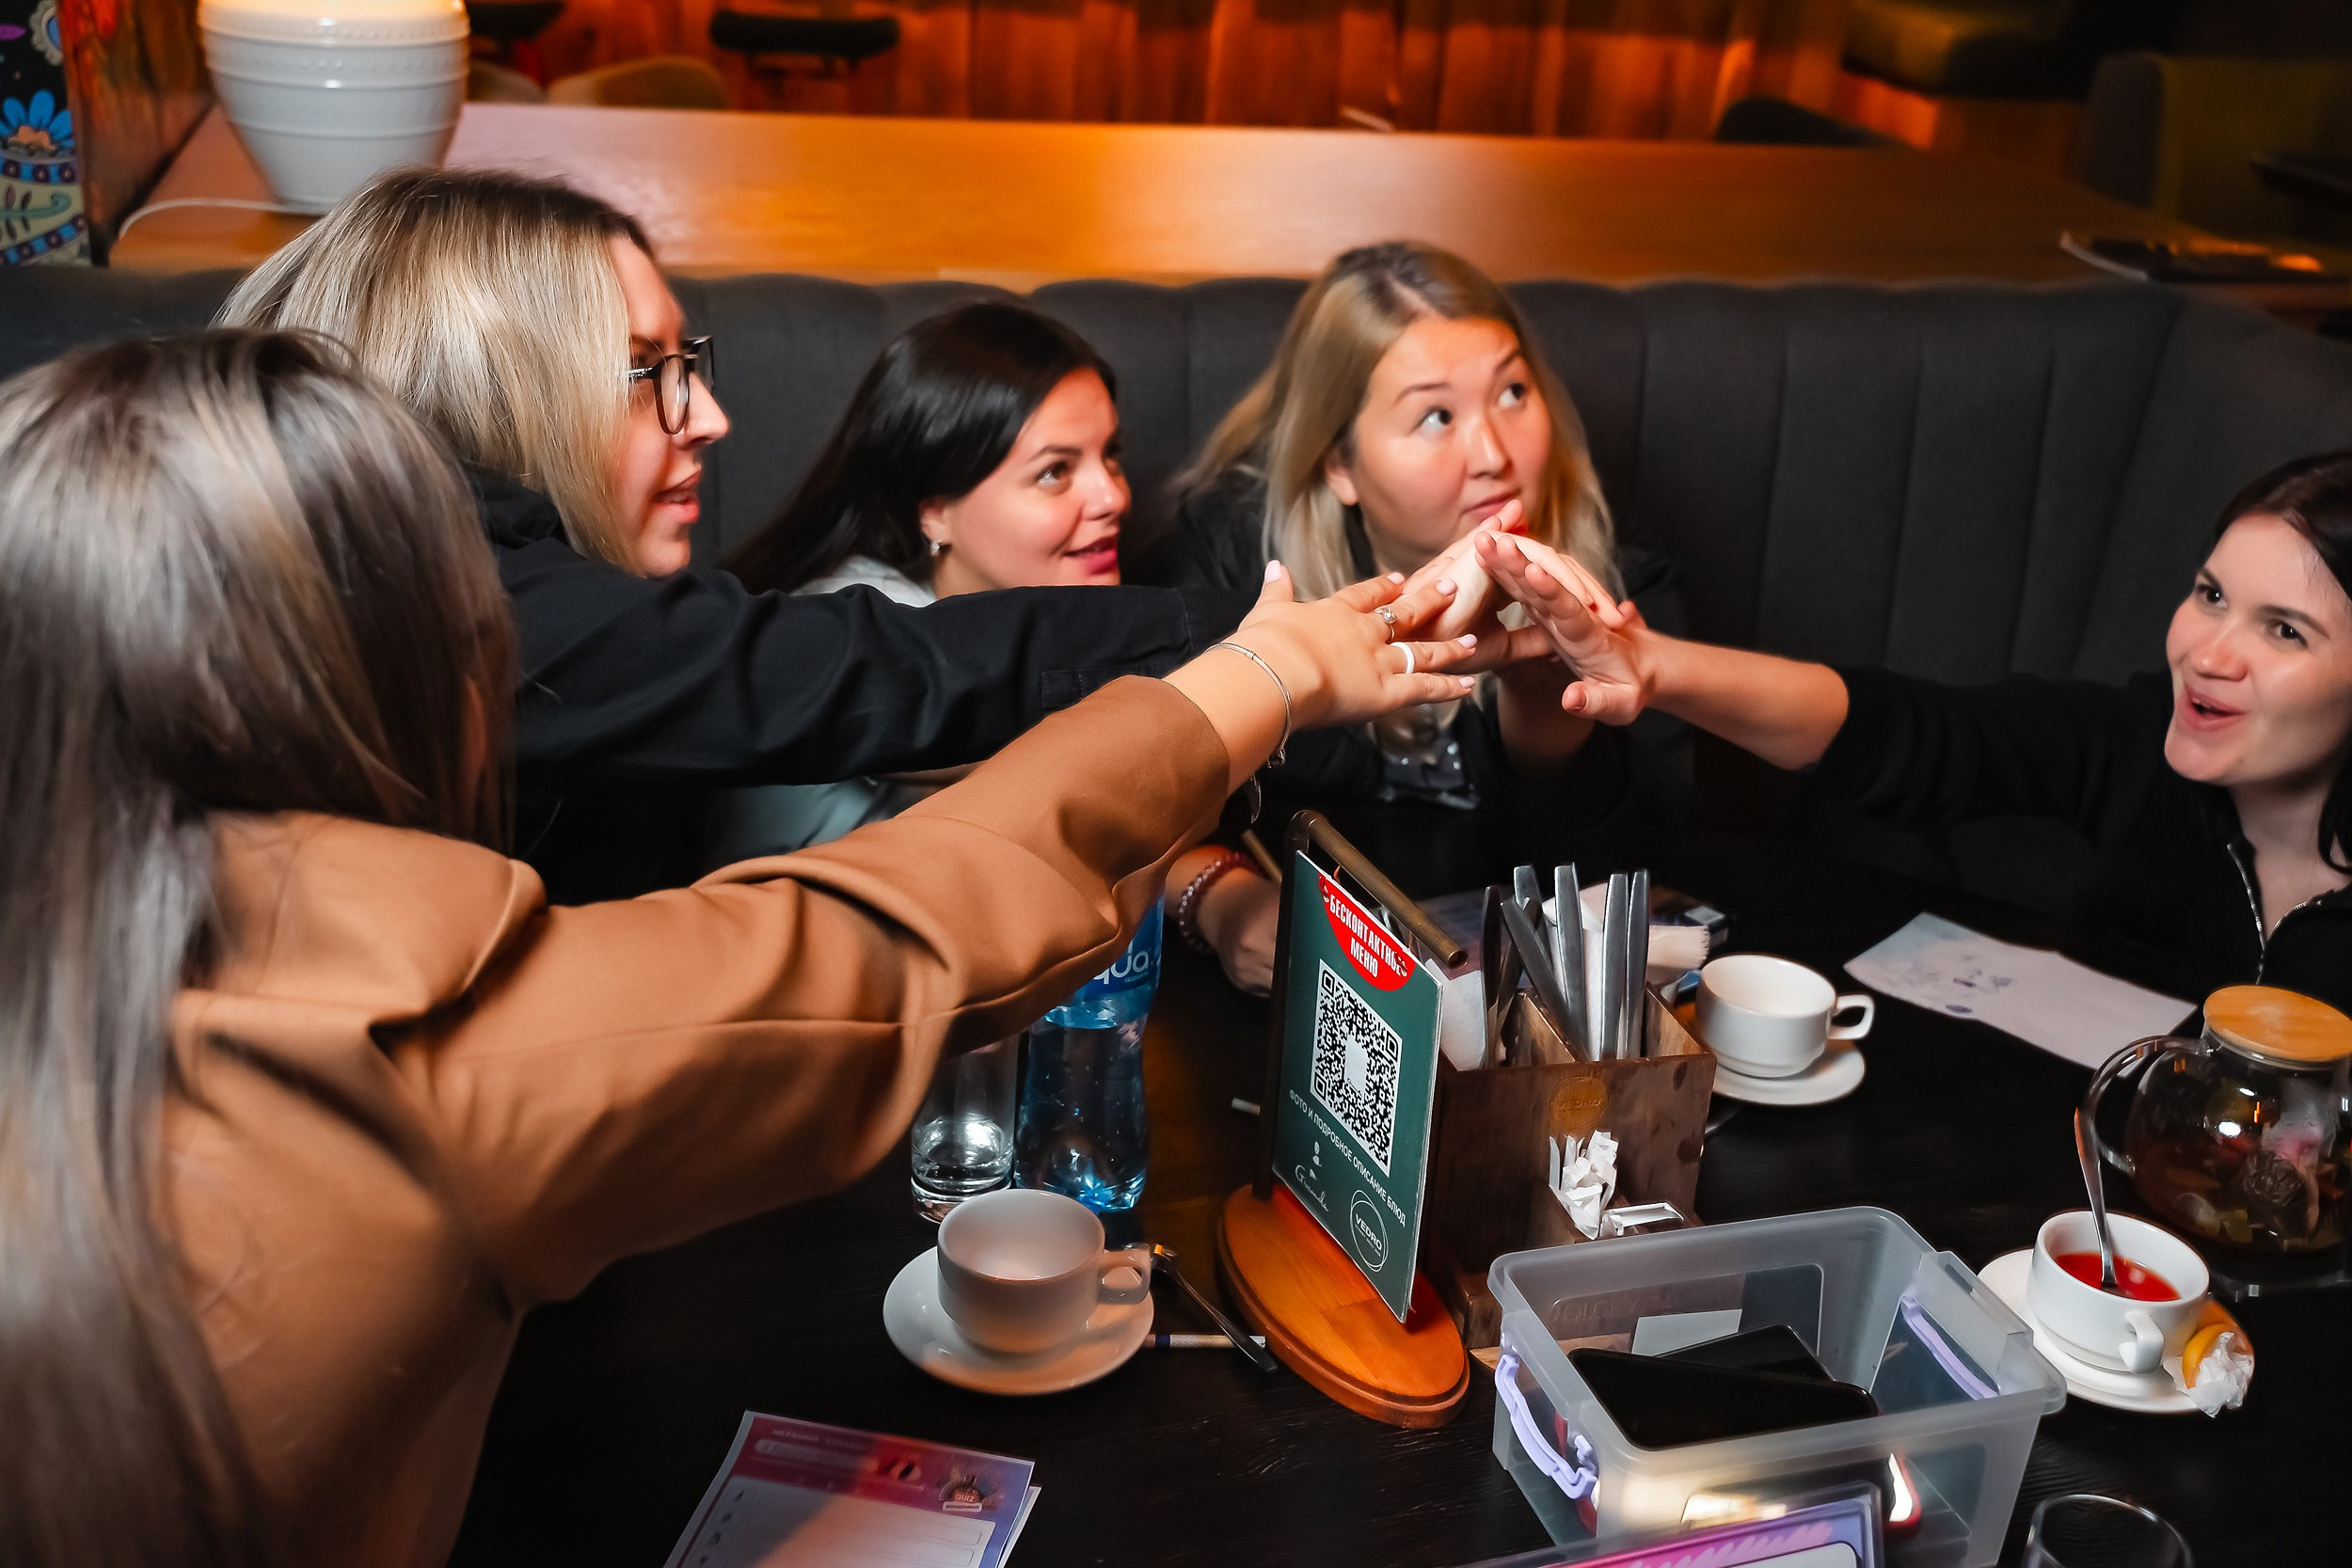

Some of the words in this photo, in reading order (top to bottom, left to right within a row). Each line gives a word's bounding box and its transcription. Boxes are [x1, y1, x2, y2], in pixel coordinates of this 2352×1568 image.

[1350, 937, 1378, 978] МЕНЮ
[1289, 1089, 1308, 1114] ФОТО
[1308, 1108, 1313, 1120] И
[1313, 1114, 1353, 1163] ПОДРОБНОЕ
[1353, 1156, 1388, 1202] ОПИСАНИЕ
[1387, 1195, 1406, 1227] БЛЮД
[1355, 1212, 1382, 1251] VEDRO
[955, 1493, 976, 1503] QUIZ
